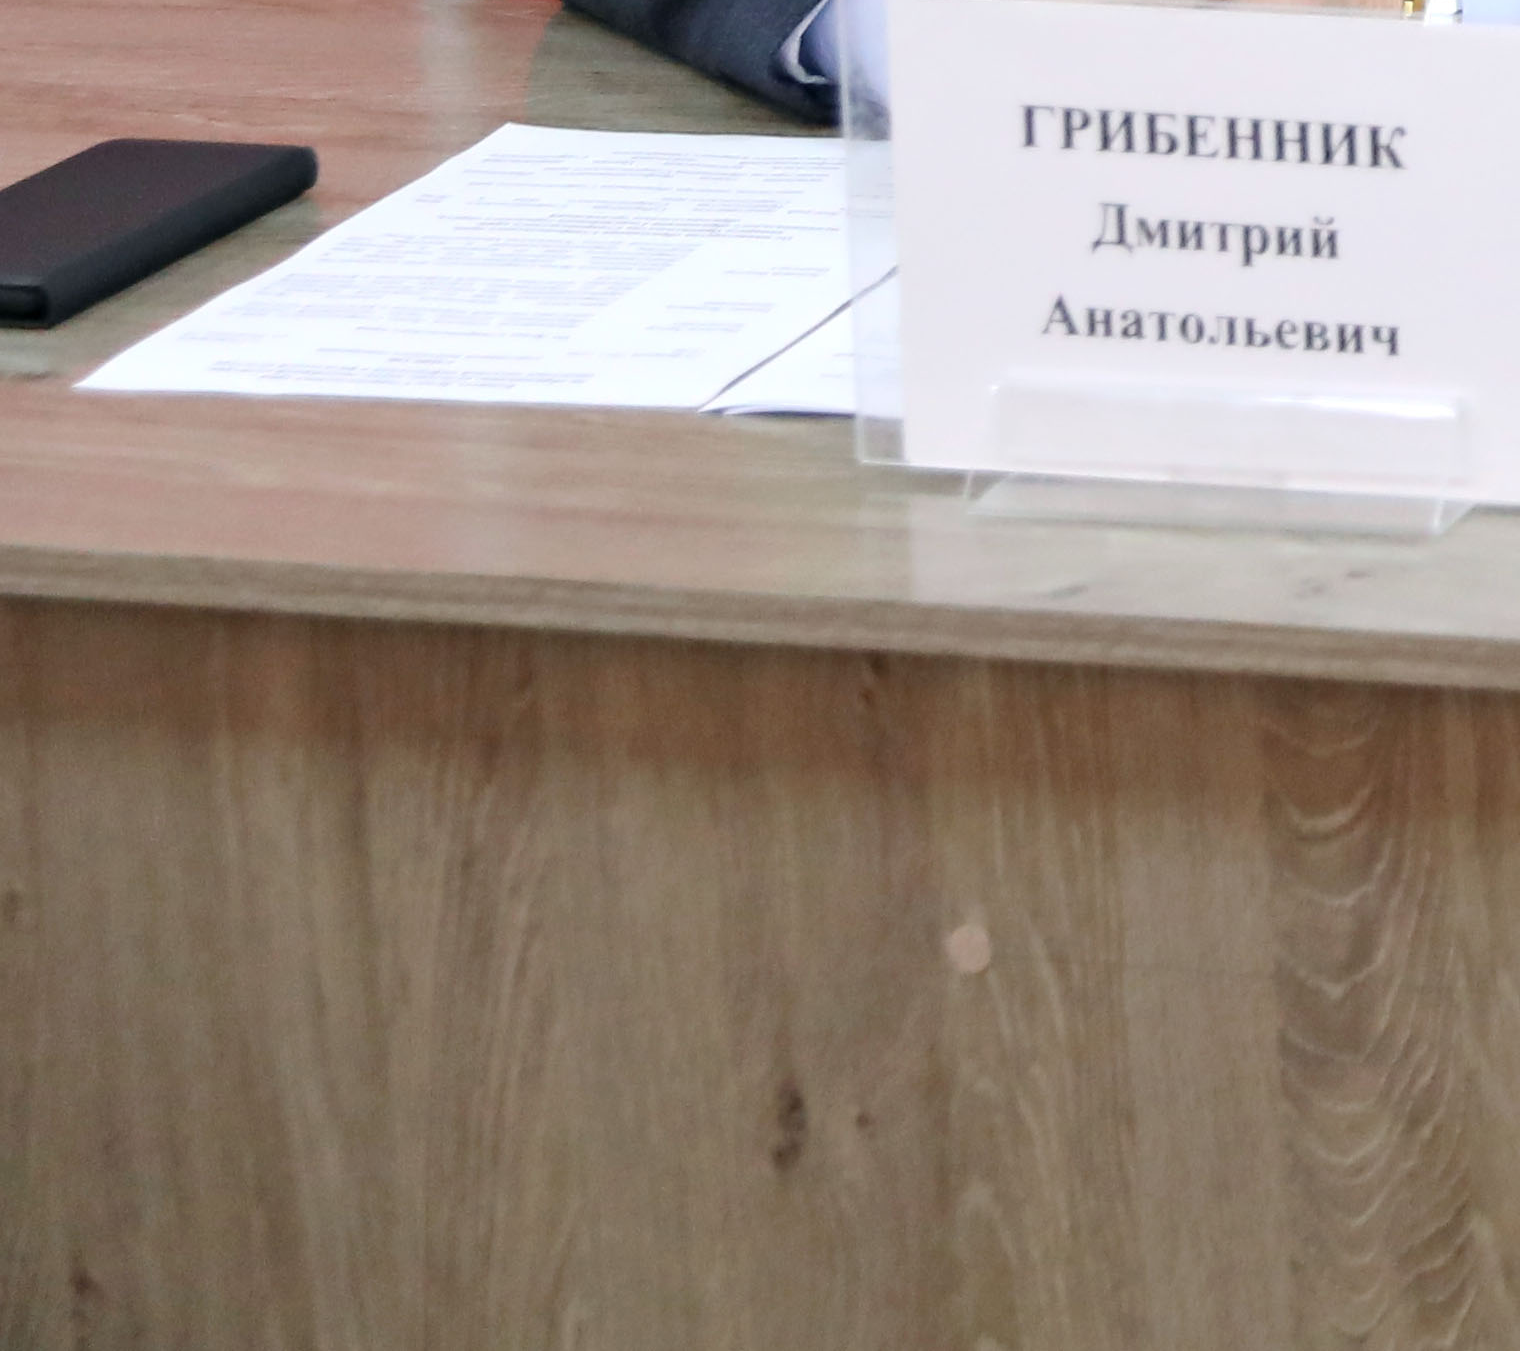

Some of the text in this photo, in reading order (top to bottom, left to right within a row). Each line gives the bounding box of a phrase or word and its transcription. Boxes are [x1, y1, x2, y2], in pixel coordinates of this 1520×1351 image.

[1020, 103, 1407, 170] ГРИБЕННИК
[1091, 202, 1339, 267] Дмитрий
[1041, 294, 1400, 357] Анатольевич
